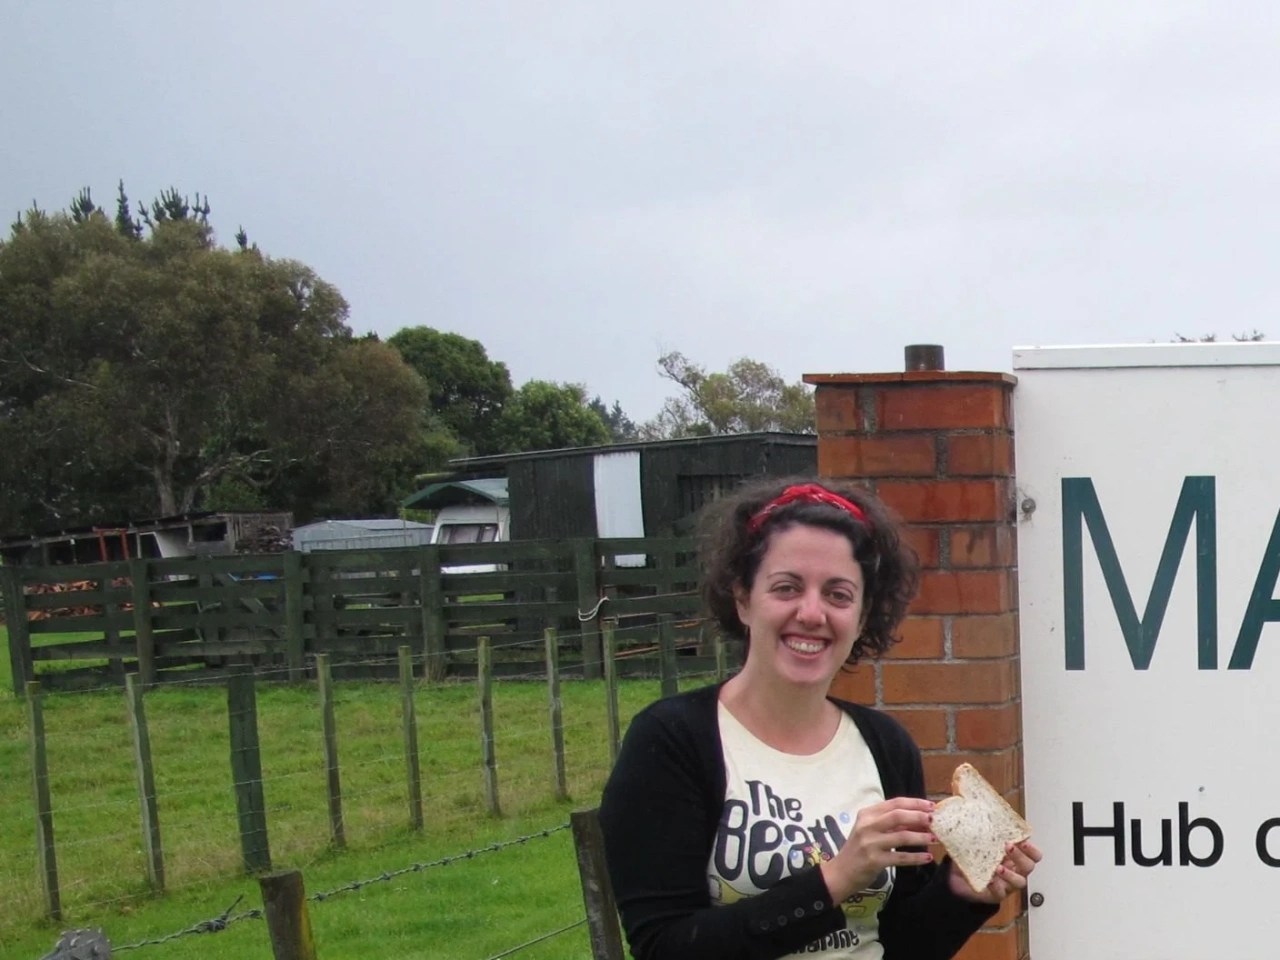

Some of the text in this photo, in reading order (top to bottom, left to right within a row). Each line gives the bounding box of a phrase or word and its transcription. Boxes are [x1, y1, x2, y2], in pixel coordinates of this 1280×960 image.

[745, 780, 803, 823] The
[1071, 801, 1224, 868] Hub
[714, 799, 890, 890] Beatl
